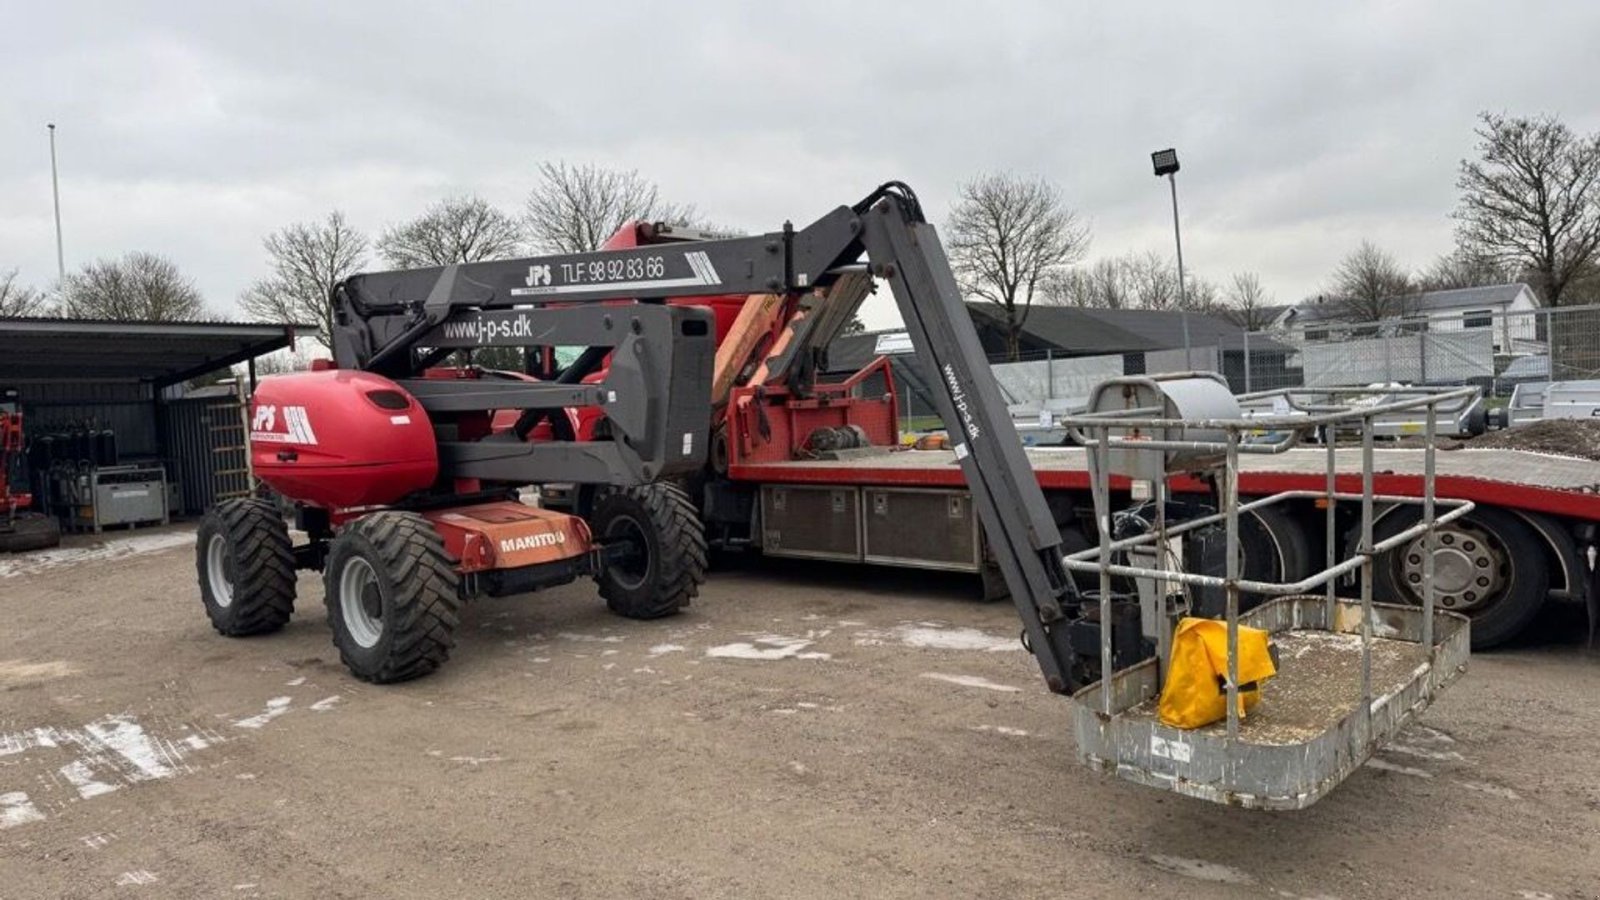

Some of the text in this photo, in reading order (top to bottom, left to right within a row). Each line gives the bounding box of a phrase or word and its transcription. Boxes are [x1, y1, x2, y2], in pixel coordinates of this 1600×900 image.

[525, 256, 664, 286] JPS TLF. 98 92 83 66
[443, 314, 532, 343] www.j-p-s.dk
[944, 363, 980, 440] www.j-p-s.dk
[252, 404, 276, 431] JPS
[501, 530, 565, 553] MANITOU
